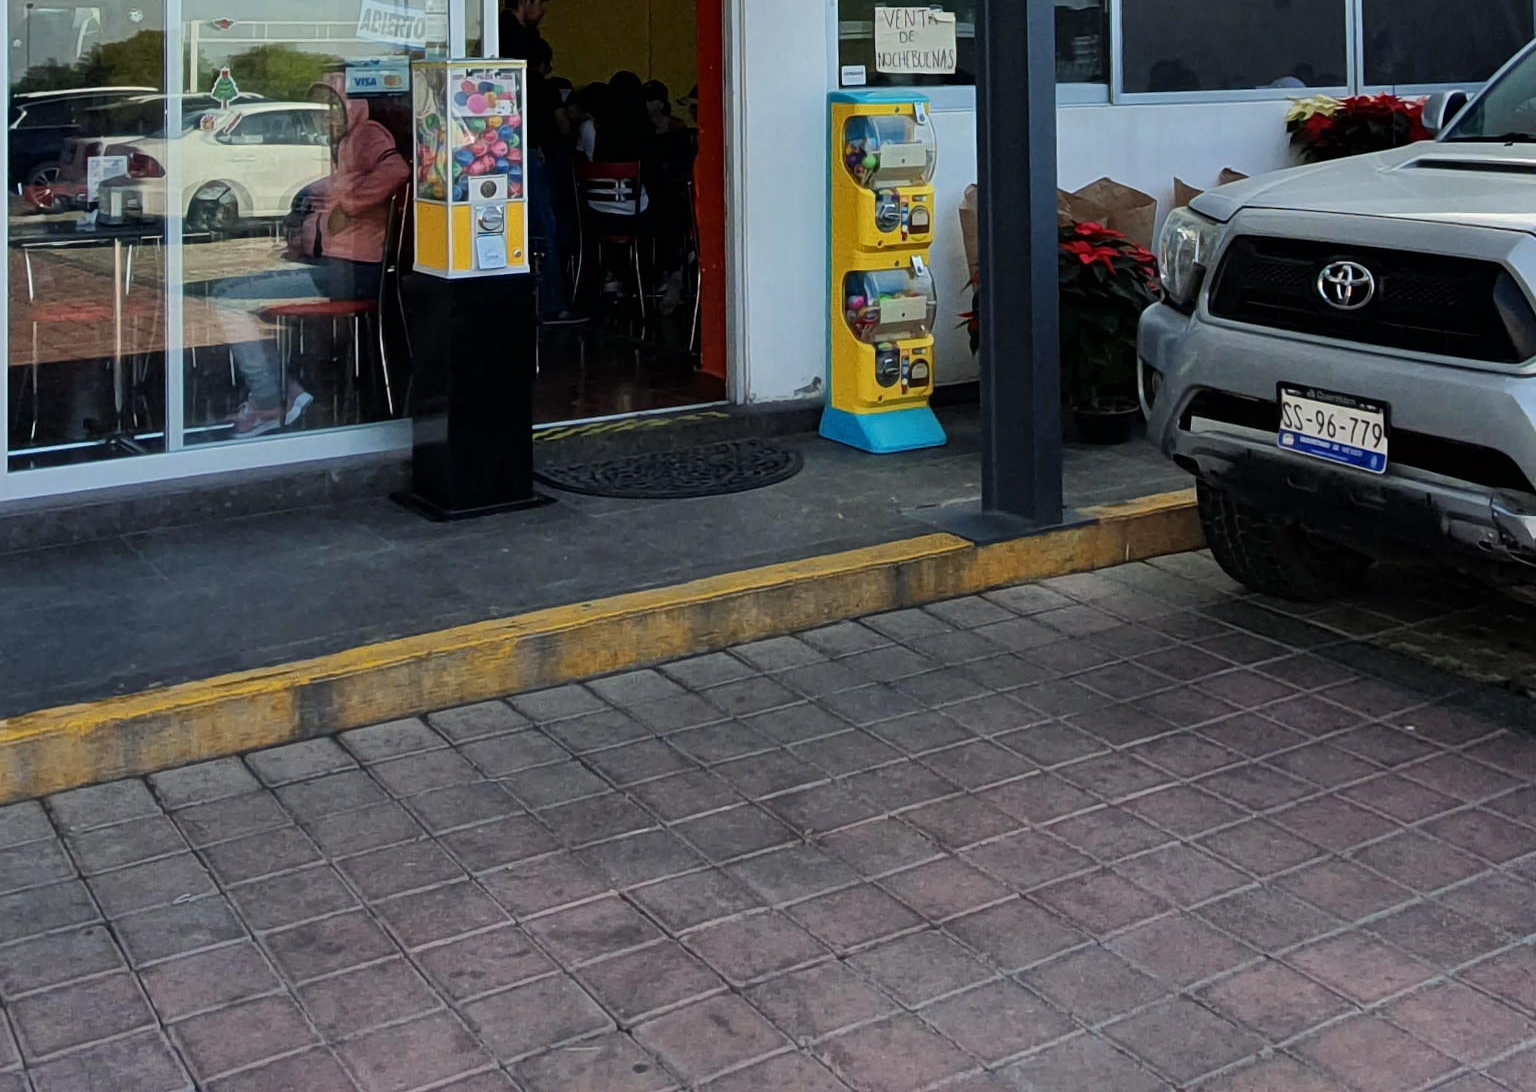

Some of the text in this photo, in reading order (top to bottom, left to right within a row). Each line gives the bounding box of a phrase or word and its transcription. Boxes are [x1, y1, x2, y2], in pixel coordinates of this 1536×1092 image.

[359, 8, 426, 40] ABIERTO
[899, 30, 914, 44] DE
[878, 48, 954, 70] NOCHEBUENAS
[353, 76, 378, 87] VISA
[1282, 401, 1383, 449] SS-96-779
